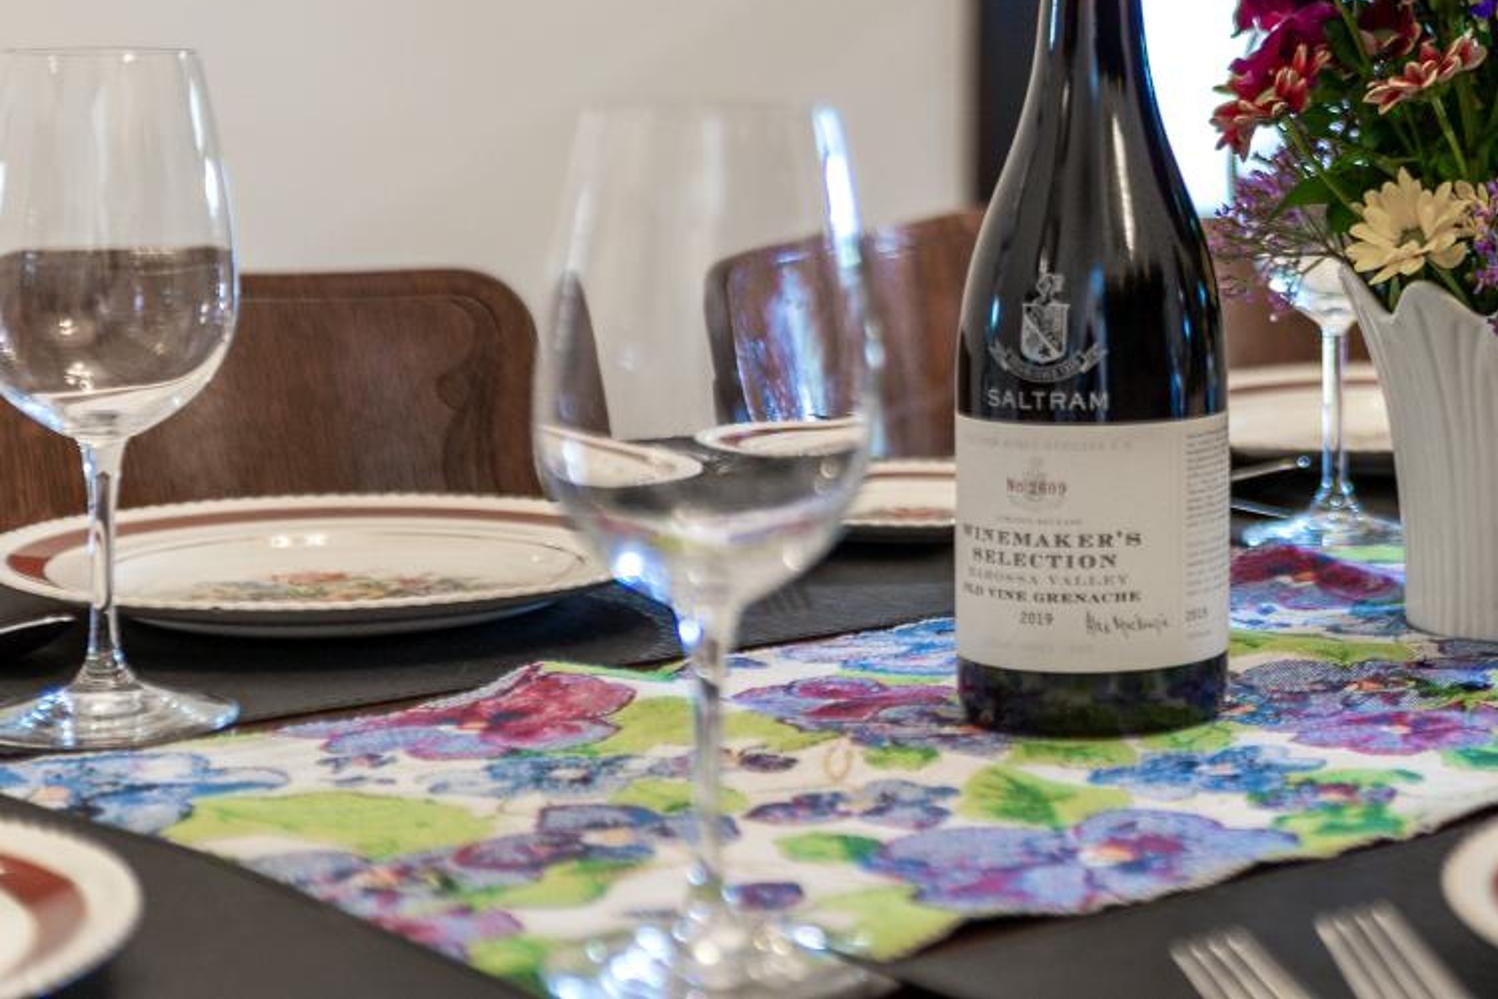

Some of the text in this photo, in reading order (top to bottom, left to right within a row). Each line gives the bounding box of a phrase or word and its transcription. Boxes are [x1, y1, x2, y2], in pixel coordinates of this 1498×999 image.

[987, 387, 1110, 412] SALTRAM
[962, 523, 1143, 548] WINEMAKER'S
[972, 548, 1117, 569] SELECTION
[1032, 591, 1143, 604] GRENACHE
